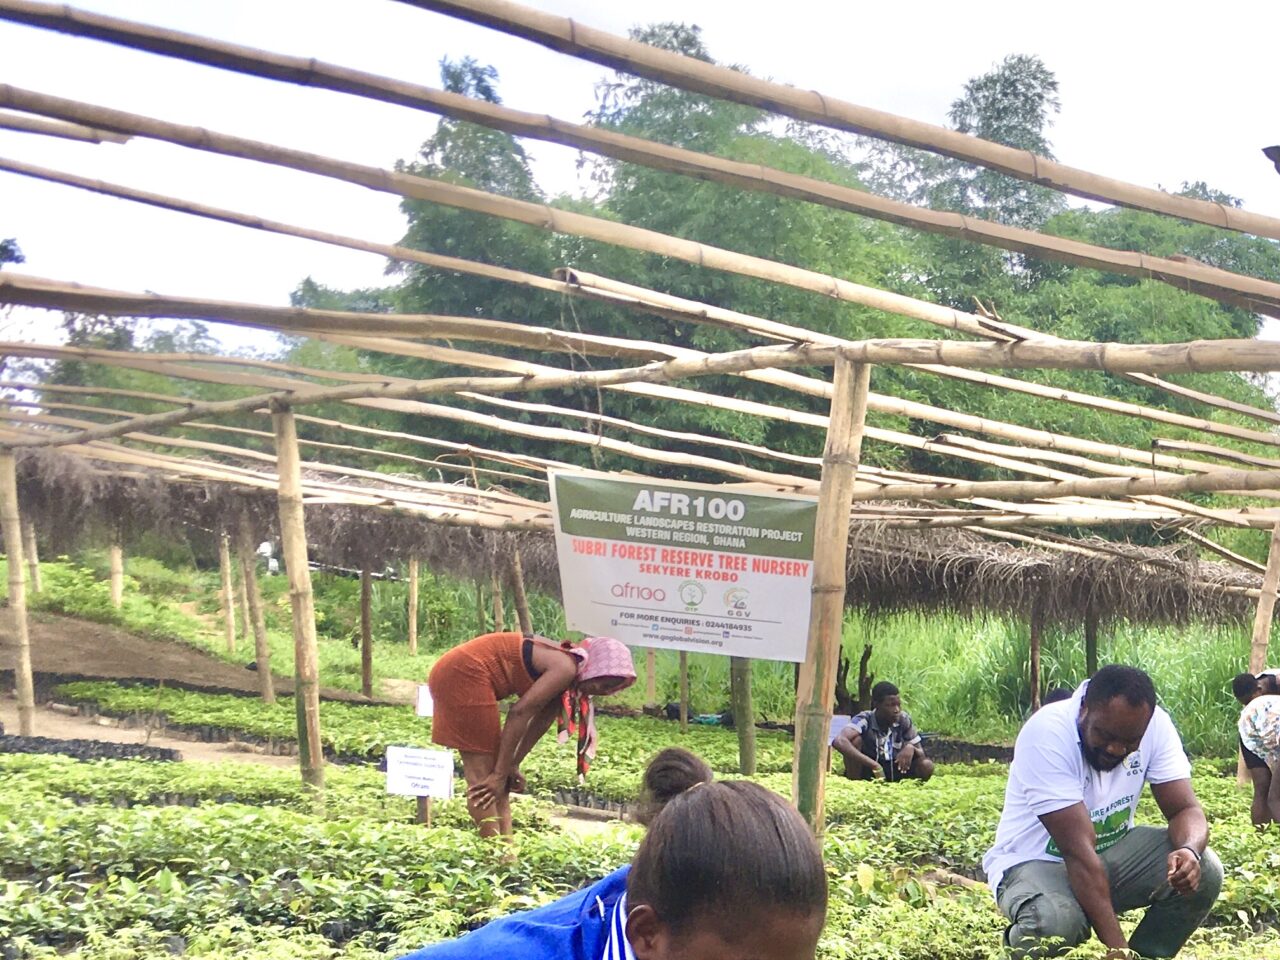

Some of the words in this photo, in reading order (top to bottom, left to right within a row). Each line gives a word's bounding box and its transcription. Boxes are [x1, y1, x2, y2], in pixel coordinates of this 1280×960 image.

[632, 489, 745, 521] AFR100
[569, 508, 633, 524] AGRICULTURE
[633, 515, 696, 531] LANDSCAPES
[696, 522, 760, 538] RESTORATION
[760, 528, 804, 542] PROJECT
[625, 526, 671, 540] WESTERN
[672, 531, 709, 545] REGION,
[713, 535, 746, 548] GHANA
[572, 539, 607, 557] SUBRI
[611, 544, 657, 562] FOREST
[661, 548, 714, 569] RESERVE
[718, 554, 748, 572] TREE
[752, 558, 809, 578] NURSERY
[639, 563, 691, 578] SEKYERE
[695, 569, 738, 582] KROBO
[636, 613, 659, 622] MORE
[660, 616, 700, 626] ENQUIRIES
[1110, 794, 1134, 810] FOREST
